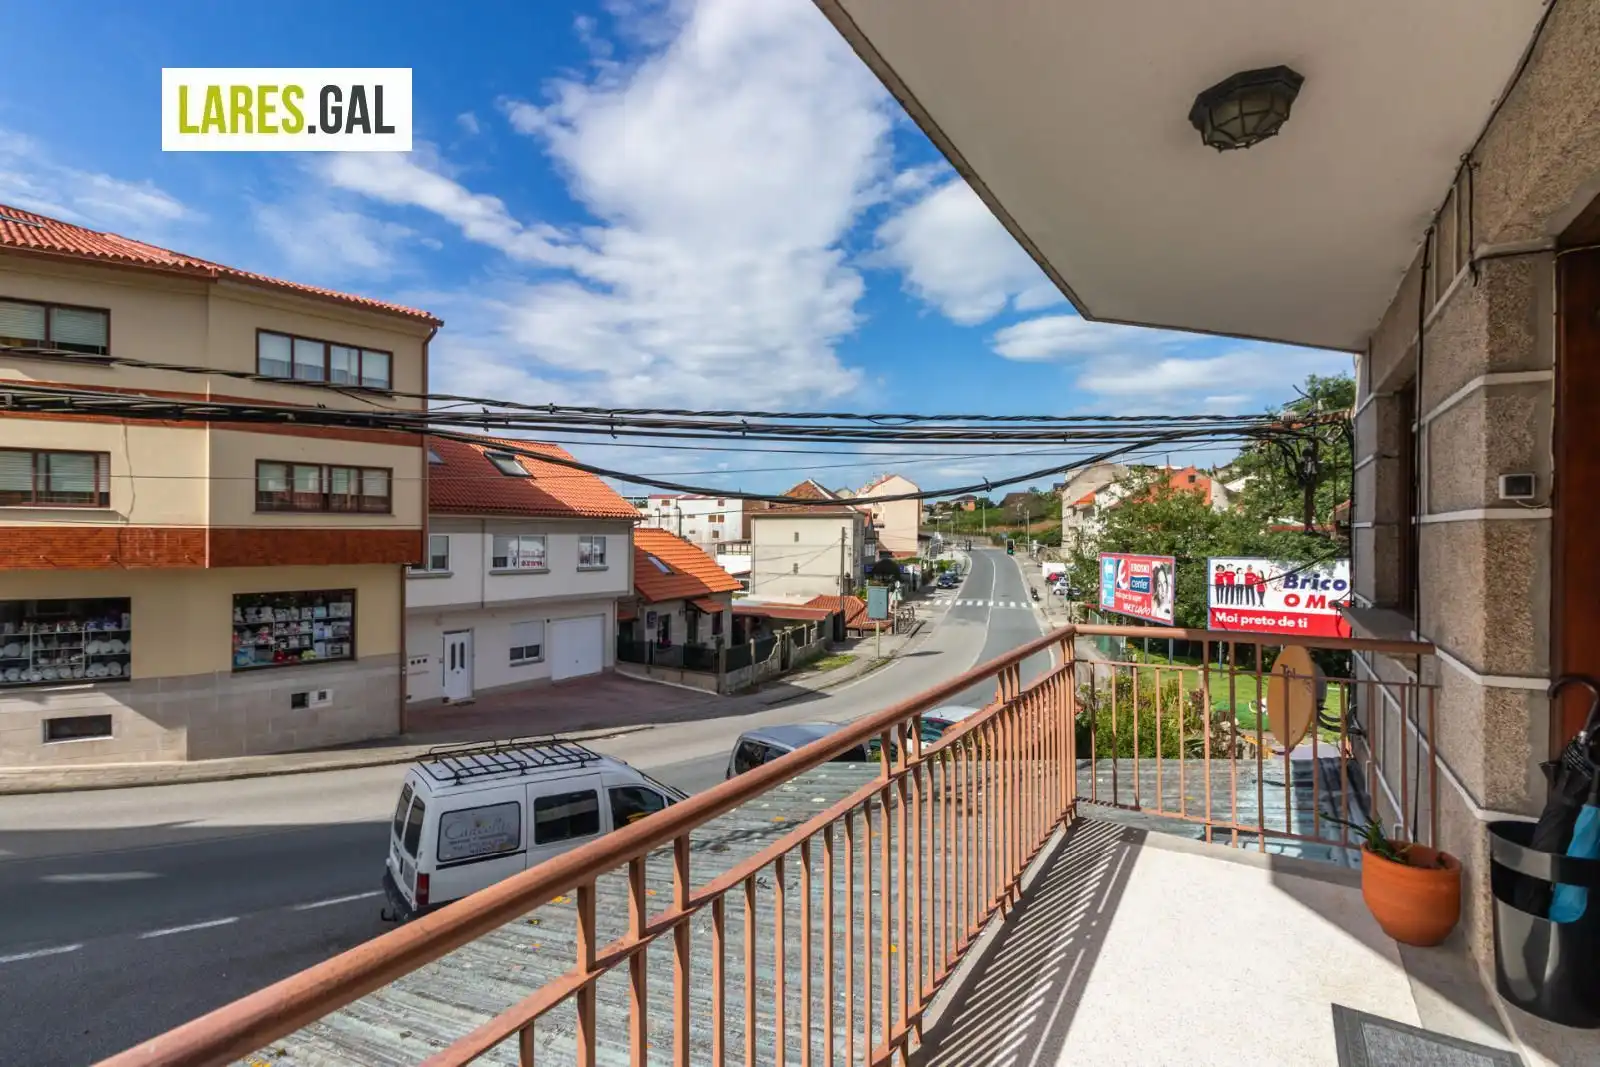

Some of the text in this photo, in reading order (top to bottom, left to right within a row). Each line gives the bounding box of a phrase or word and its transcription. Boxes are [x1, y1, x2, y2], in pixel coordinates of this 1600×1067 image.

[1131, 579, 1149, 590] center
[1283, 573, 1347, 591] Brico
[1215, 612, 1308, 628] Moi preto de ti
